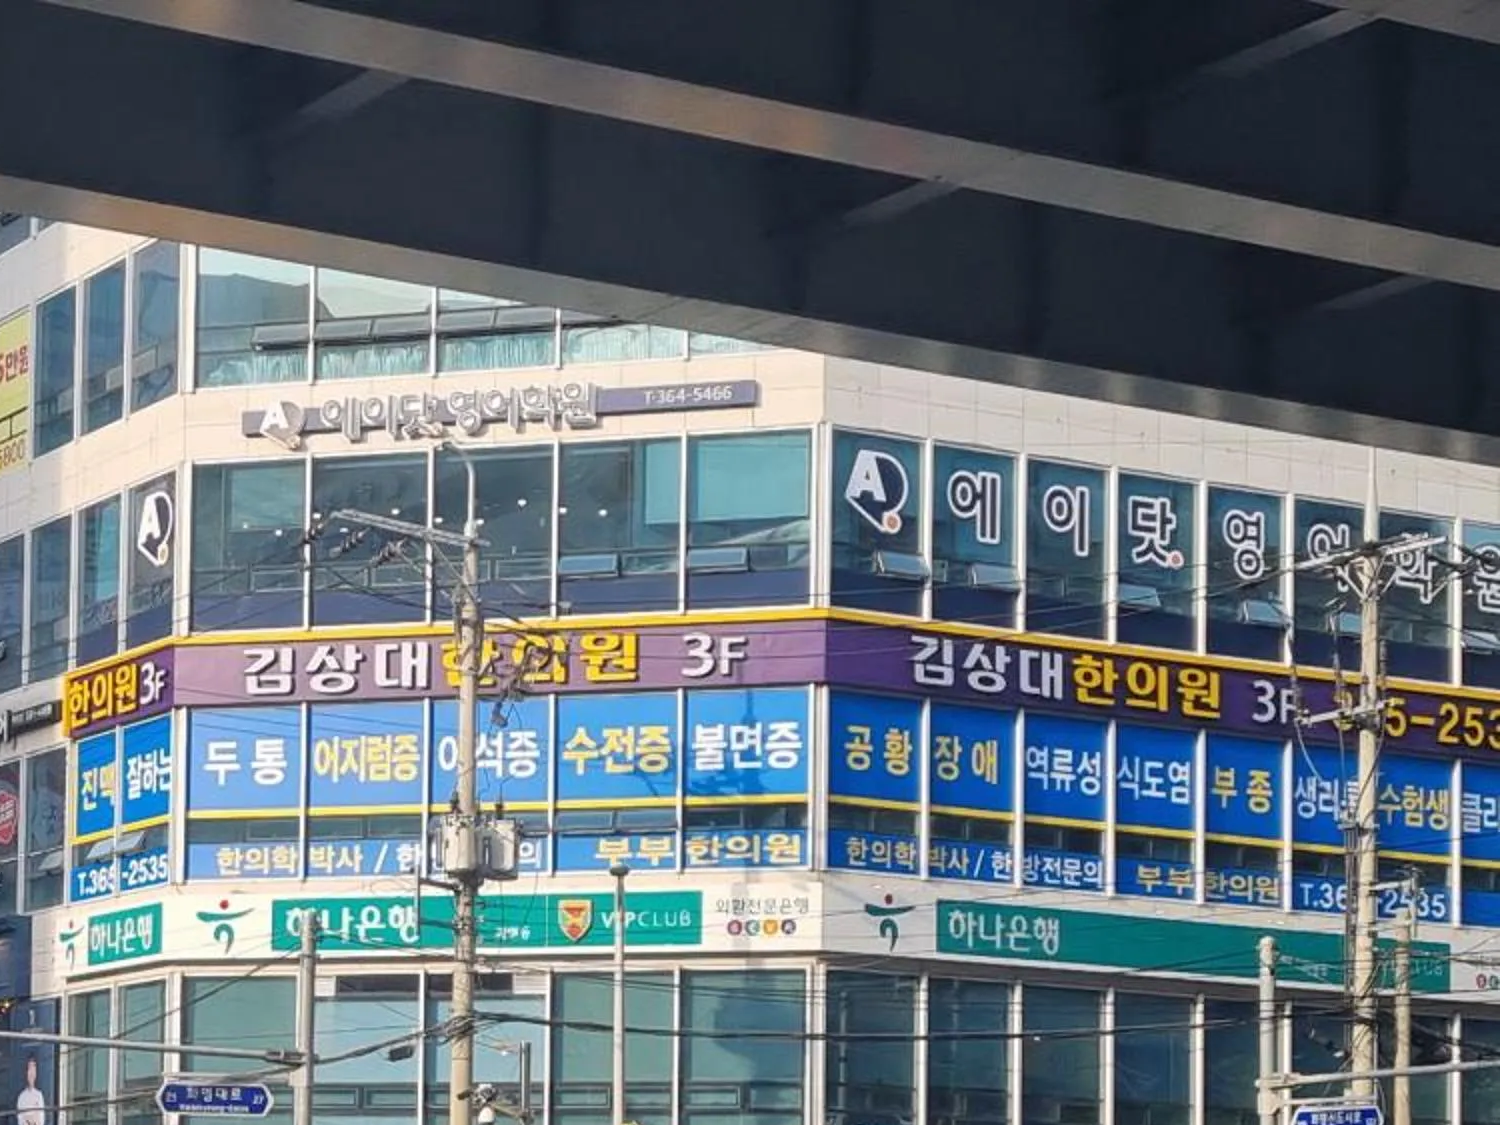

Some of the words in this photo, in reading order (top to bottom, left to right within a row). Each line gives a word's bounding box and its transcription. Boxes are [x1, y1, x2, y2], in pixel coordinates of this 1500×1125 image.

[680, 631, 749, 680] 3F
[67, 661, 139, 730] 한의원
[313, 733, 421, 783] 어지럼증
[562, 725, 673, 777] 수전증
[691, 721, 803, 773] 불면증
[947, 906, 1062, 956] 하나은행
